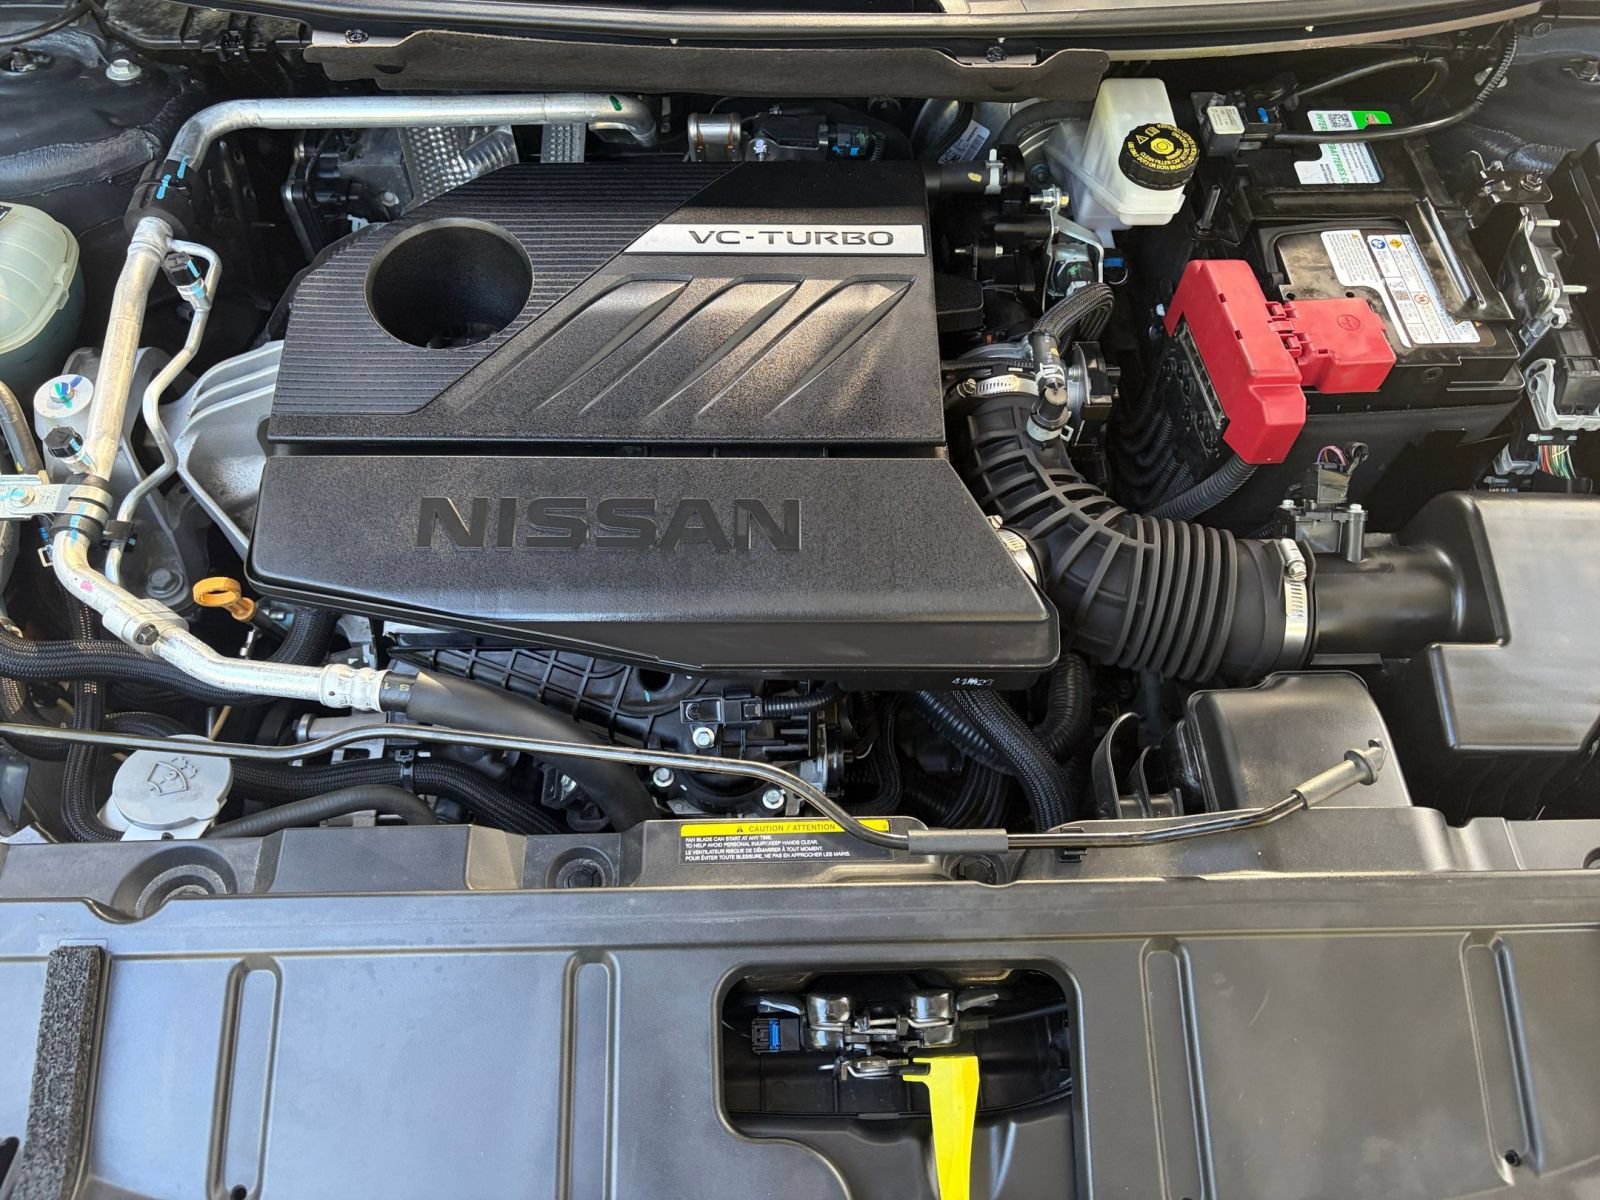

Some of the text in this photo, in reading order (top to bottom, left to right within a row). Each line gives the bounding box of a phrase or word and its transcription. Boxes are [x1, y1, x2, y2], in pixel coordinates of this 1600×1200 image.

[1140, 152, 1154, 162] CLEAN
[688, 230, 894, 246] VC-TURBO
[416, 496, 802, 551] NISSAN
